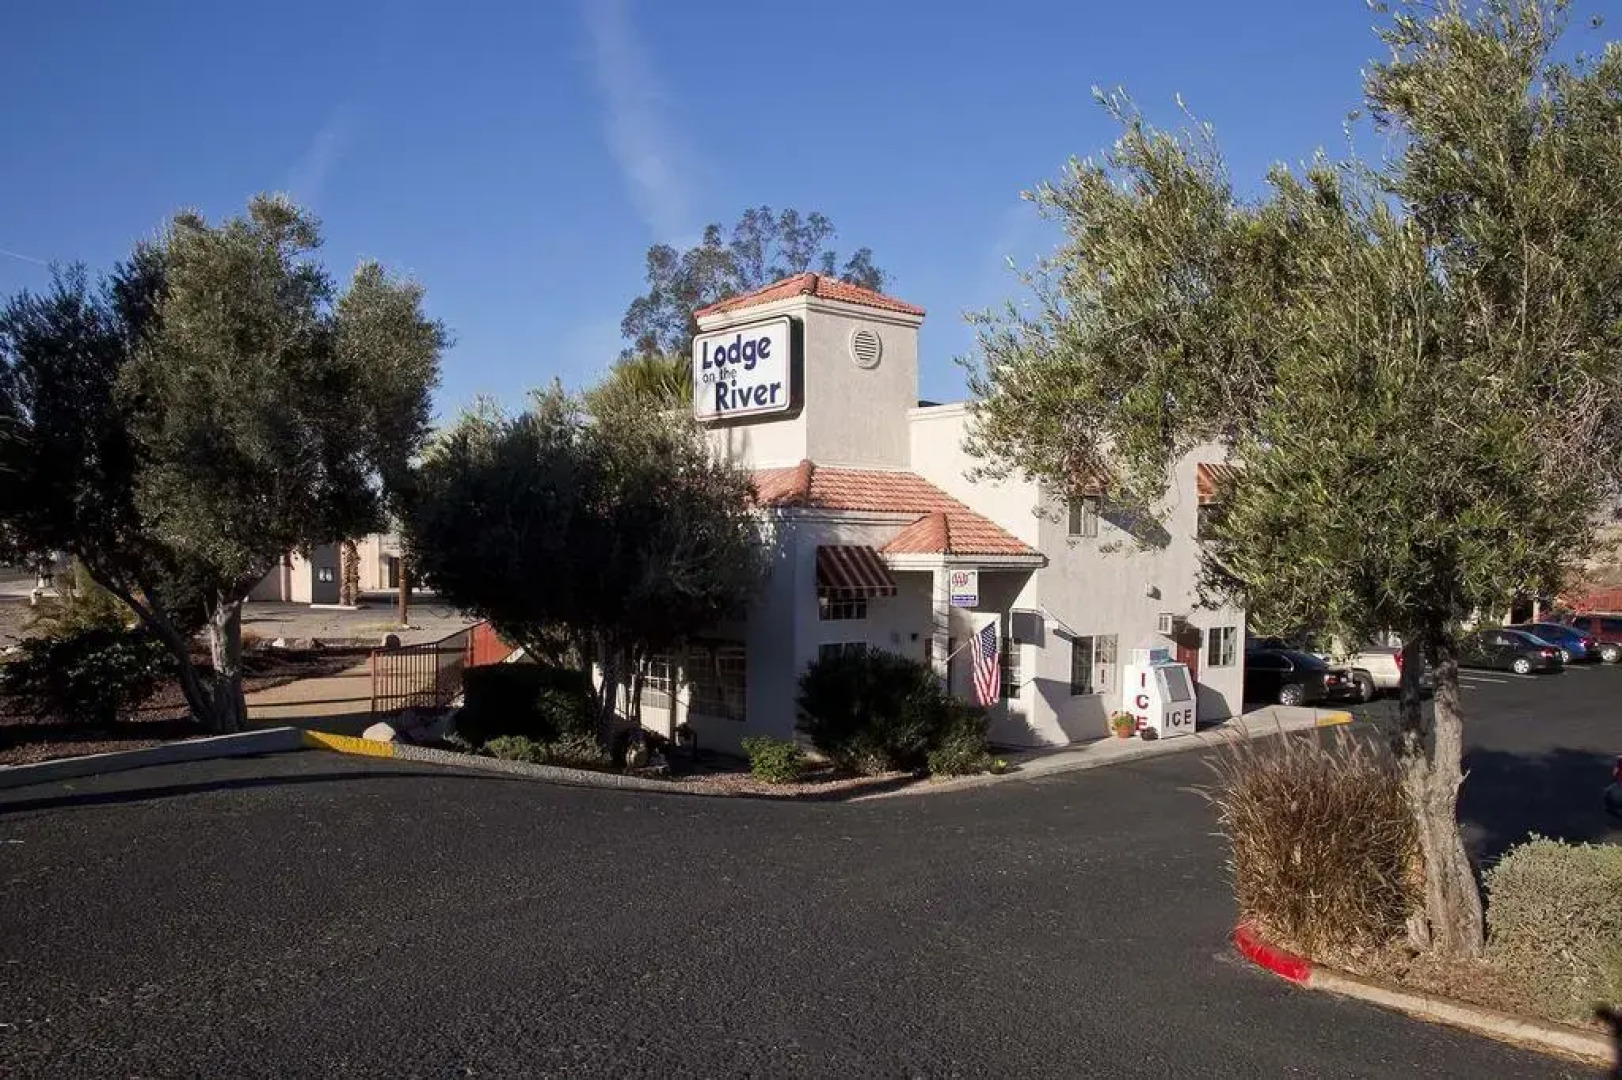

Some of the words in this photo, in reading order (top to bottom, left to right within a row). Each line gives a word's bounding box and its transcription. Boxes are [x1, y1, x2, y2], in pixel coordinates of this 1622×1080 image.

[702, 334, 771, 370] Lodge
[702, 372, 715, 384] on
[719, 367, 737, 380] the
[716, 380, 781, 411] River
[1135, 672, 1149, 732] ICE
[1165, 709, 1192, 728] ICE
